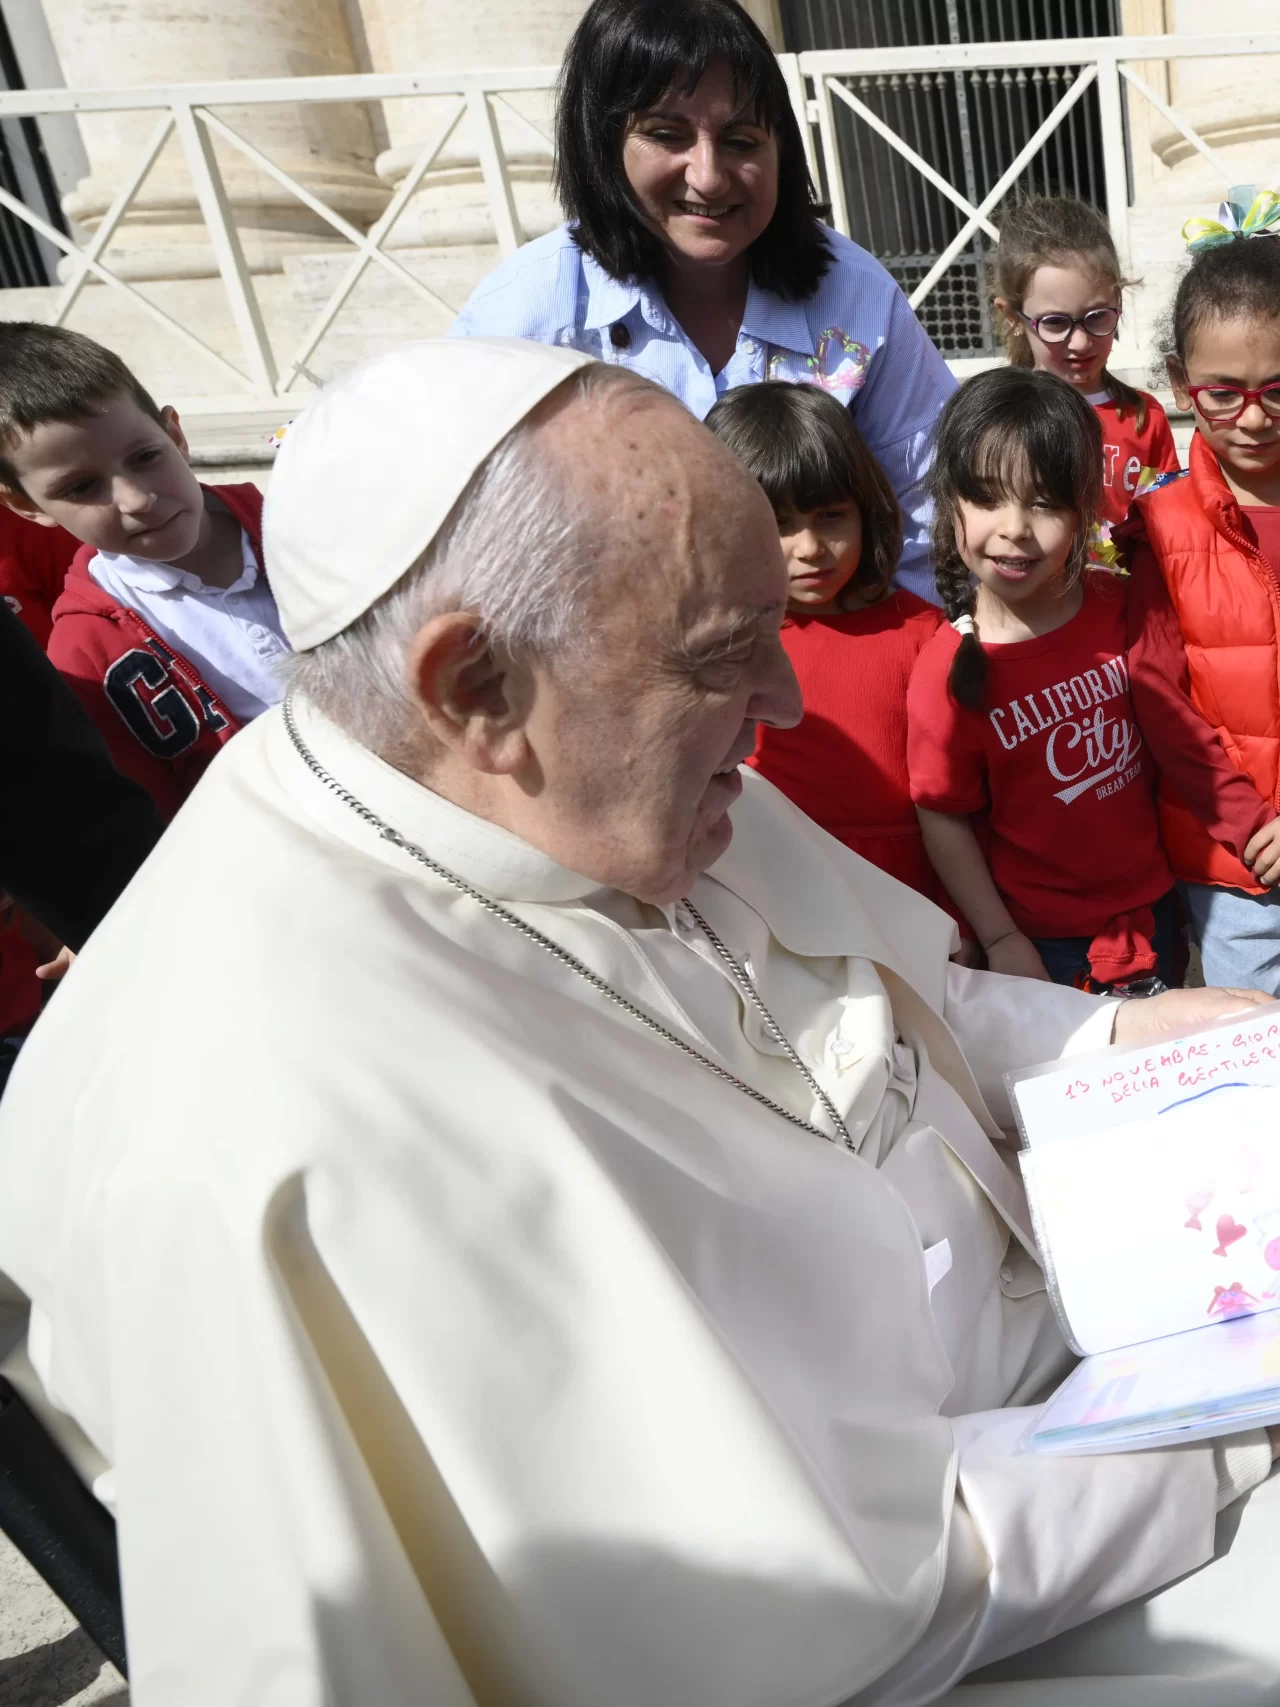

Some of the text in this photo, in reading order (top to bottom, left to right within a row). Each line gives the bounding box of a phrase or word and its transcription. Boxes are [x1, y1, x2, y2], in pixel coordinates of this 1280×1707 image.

[989, 654, 1130, 750] CALIFORNI
[1045, 706, 1142, 782] City
[1096, 775, 1126, 801] DREAM
[1065, 1080, 1090, 1100] 13
[1102, 1043, 1209, 1087] NOVEMBRE
